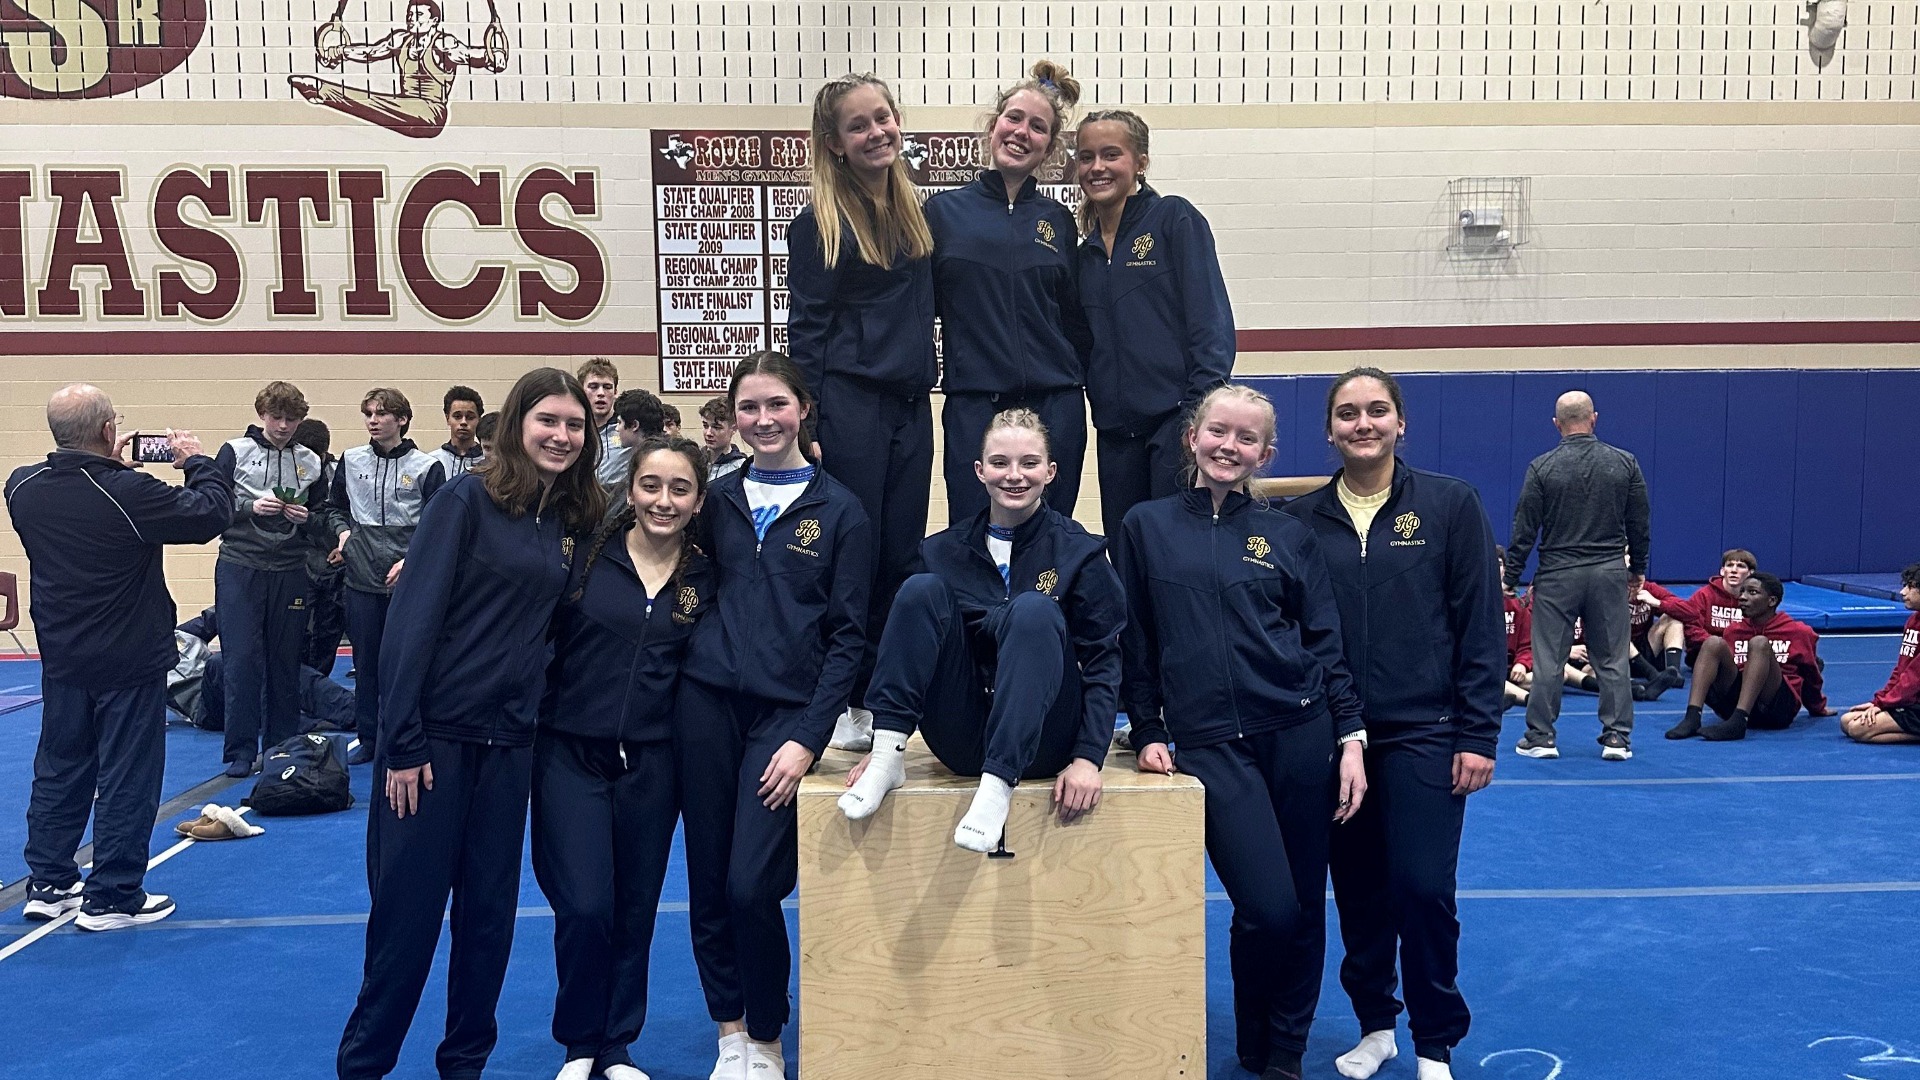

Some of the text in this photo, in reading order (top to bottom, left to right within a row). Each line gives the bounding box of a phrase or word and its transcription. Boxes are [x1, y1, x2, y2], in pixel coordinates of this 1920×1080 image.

[695, 136, 812, 168] ROUGH RID
[696, 170, 740, 181] MEN'S
[929, 170, 973, 182] MEN'S
[664, 187, 754, 205] STATE QUALIFIER
[664, 207, 755, 218] DIST CHAMP 2008
[775, 207, 798, 217] DIST
[665, 223, 755, 240] STATE QUALIFIER
[698, 242, 722, 253] 2009
[665, 258, 718, 274] REGIONAL
[721, 258, 757, 274] CHAMP
[667, 276, 757, 286] DIST CHAMP 2010
[671, 293, 753, 309] STATE FINALIST
[702, 310, 726, 320] 2010
[667, 327, 720, 343] REGIONAL
[723, 327, 759, 343] CHAMP
[669, 345, 758, 354] DIST CHAMP 2011
[673, 361, 705, 377] STATE
[675, 379, 727, 389] 3rd PLACE
[1390, 539, 1426, 547] GYMNASTICS
[786, 543, 819, 558] GYMNASTICS
[1243, 556, 1275, 569] GYMNASTICS
